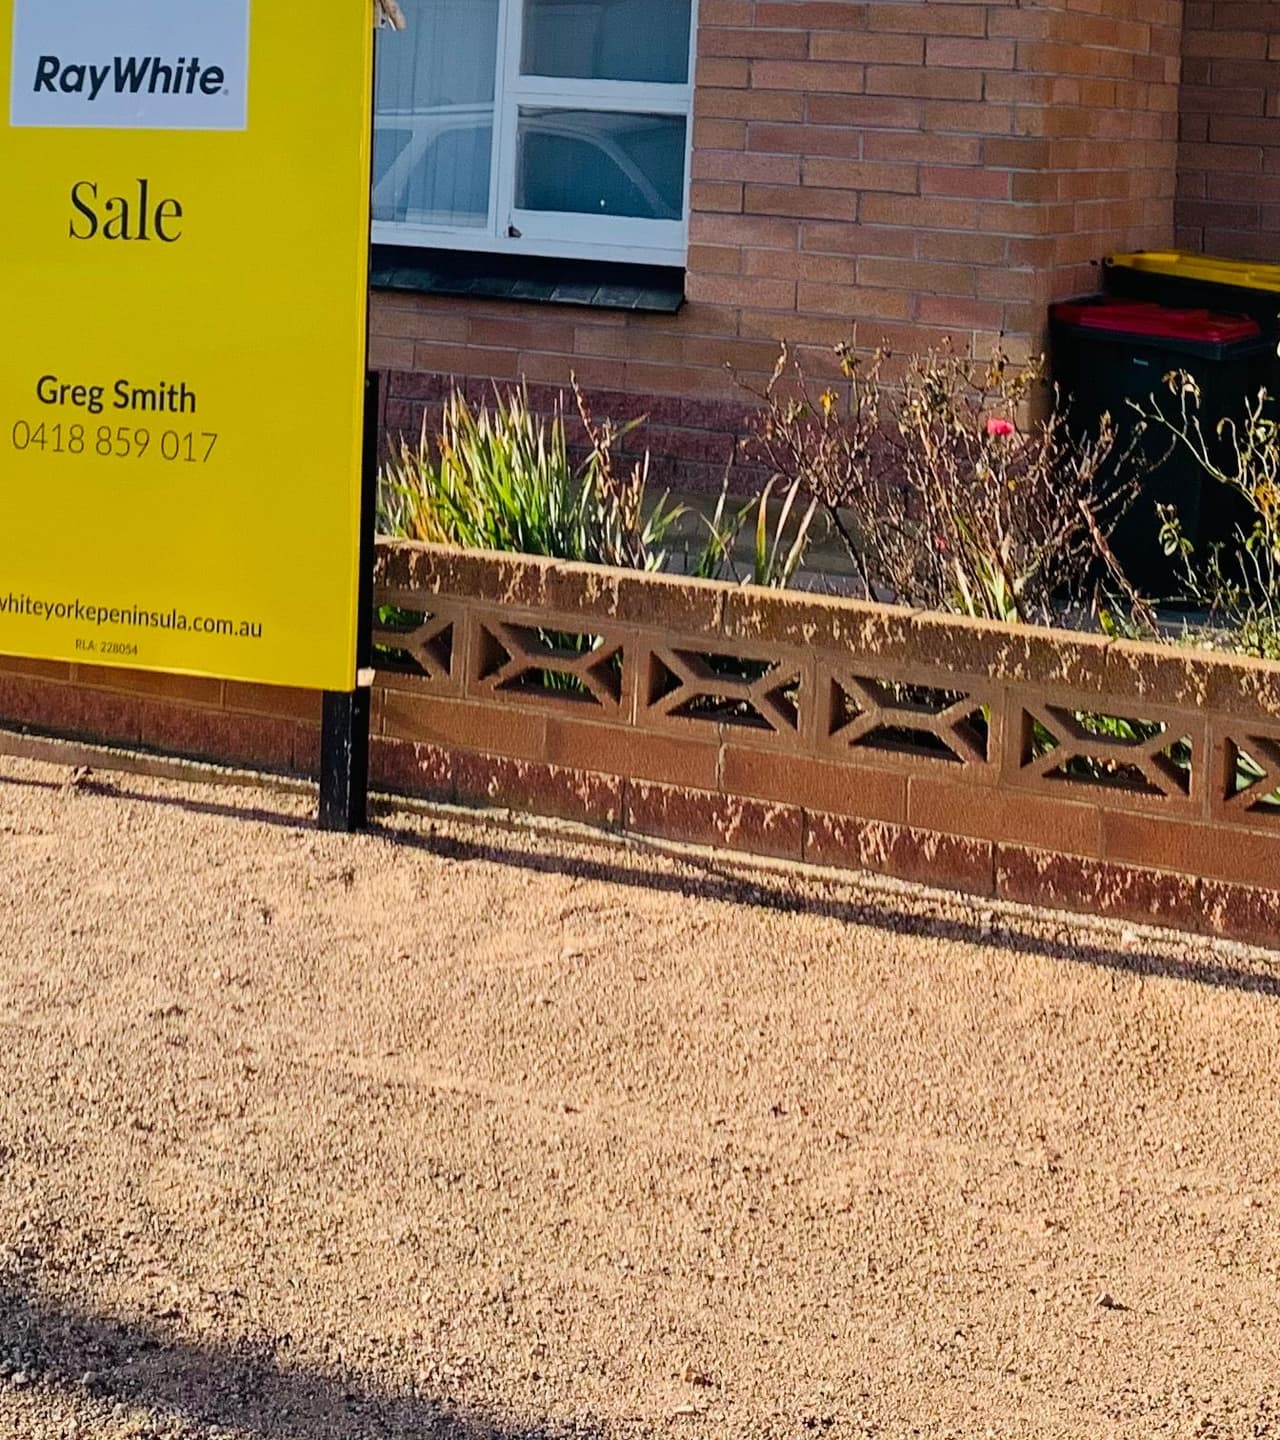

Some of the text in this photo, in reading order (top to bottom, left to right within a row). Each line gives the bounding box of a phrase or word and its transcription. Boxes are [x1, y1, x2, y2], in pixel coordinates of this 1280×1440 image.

[68, 178, 183, 243] Sale
[36, 374, 196, 415] Greg Smith
[12, 420, 218, 463] 0418 859 017
